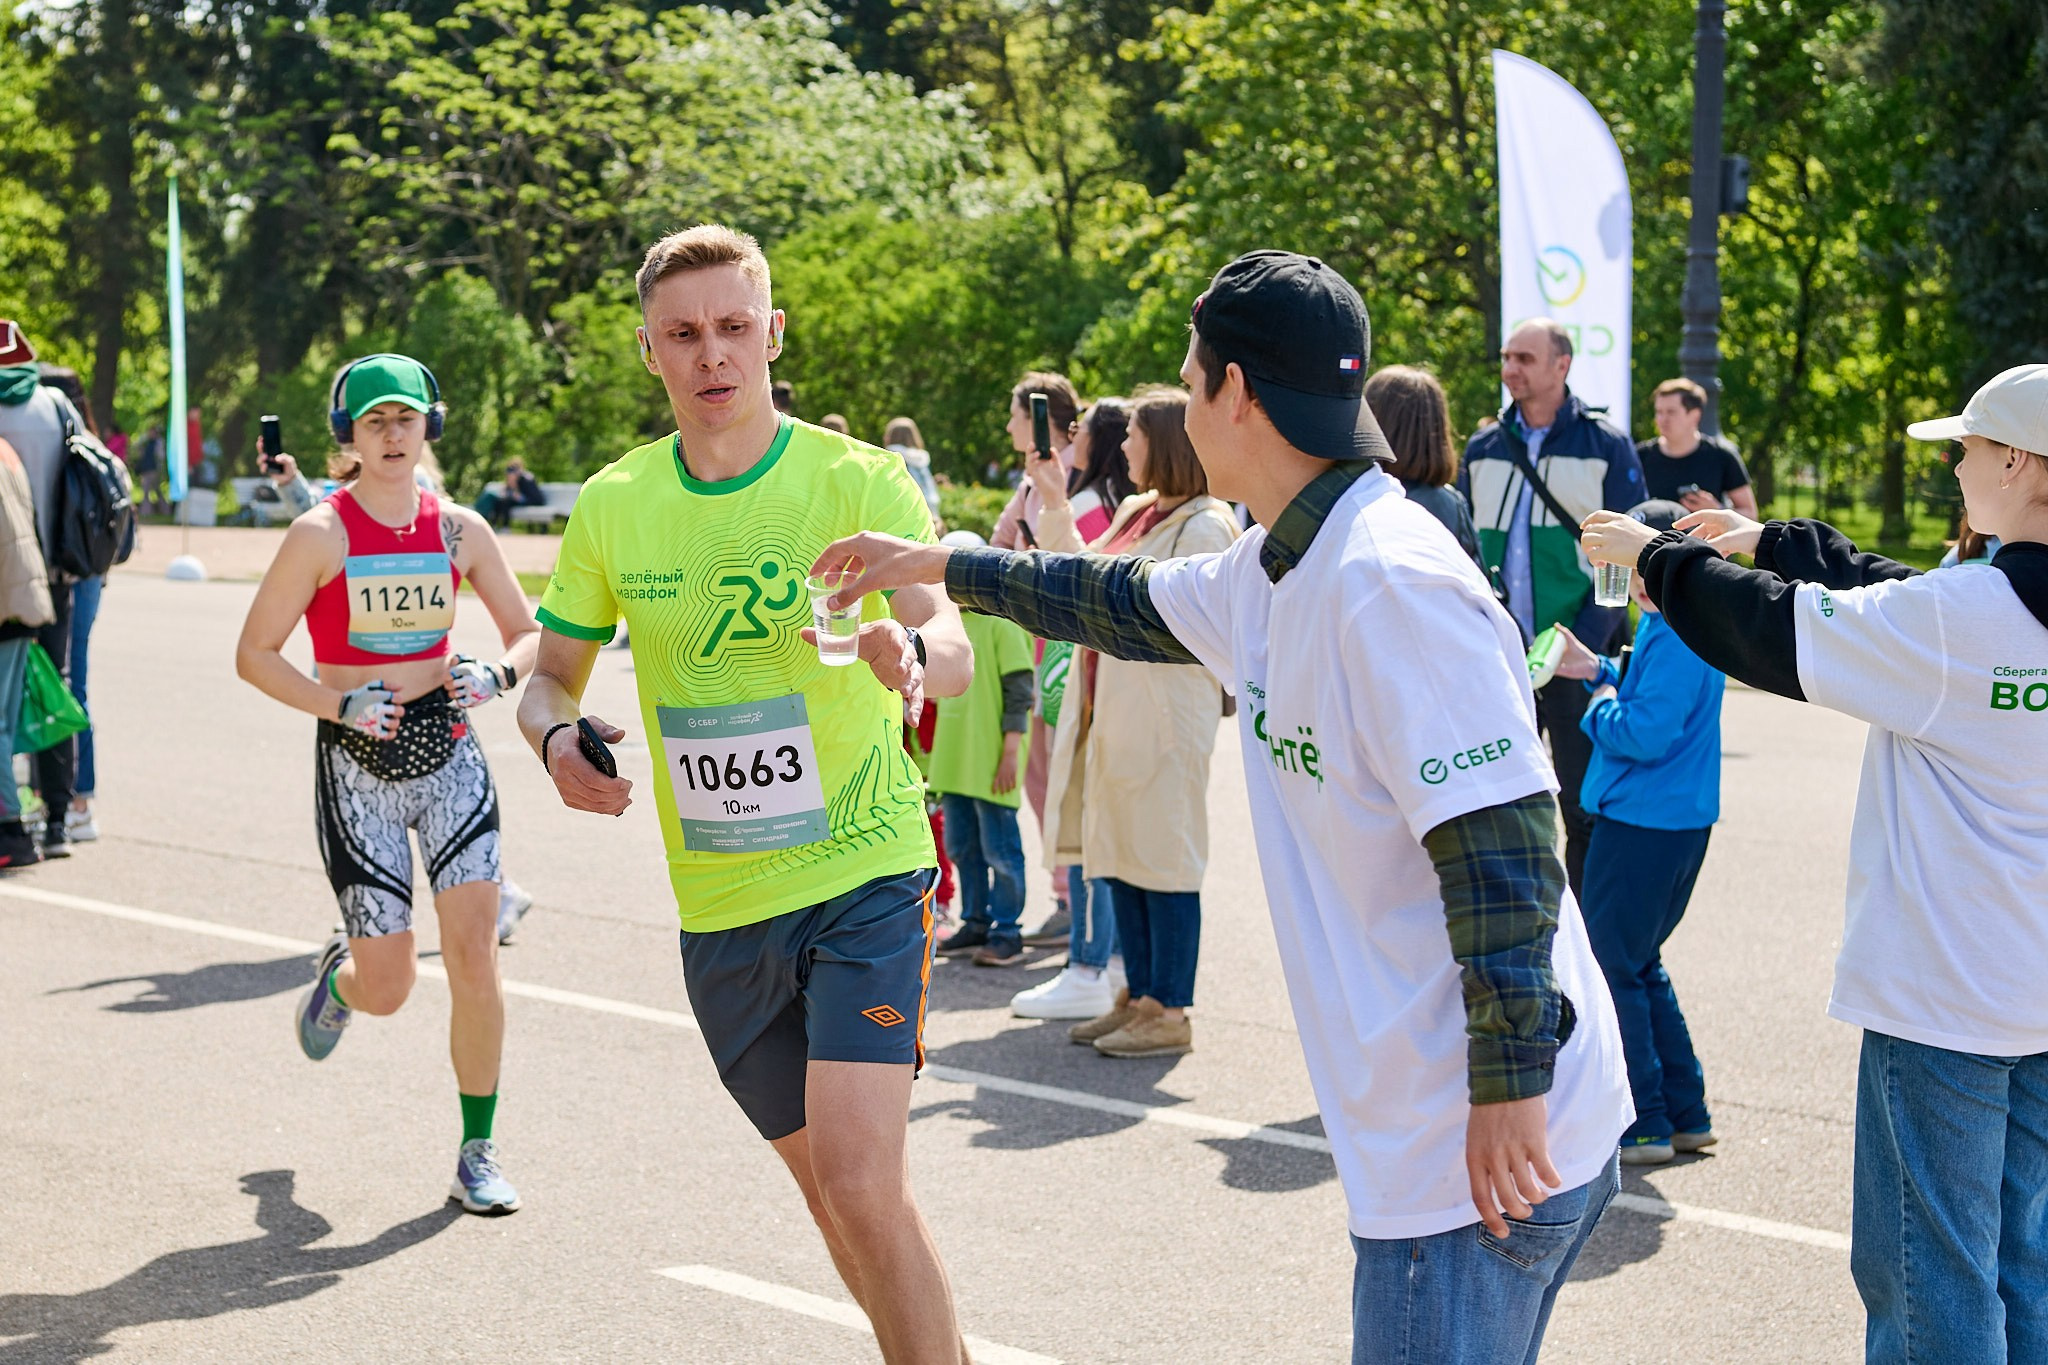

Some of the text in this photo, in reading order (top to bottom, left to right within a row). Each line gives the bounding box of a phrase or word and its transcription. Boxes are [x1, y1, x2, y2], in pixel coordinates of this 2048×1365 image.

[620, 568, 684, 584] зелёный
[361, 585, 445, 612] 11214
[616, 585, 677, 602] марафон
[1245, 680, 1266, 699] бер
[697, 718, 718, 727] СБЕР
[1453, 738, 1512, 770] СБЕР
[679, 745, 803, 791] 10663
